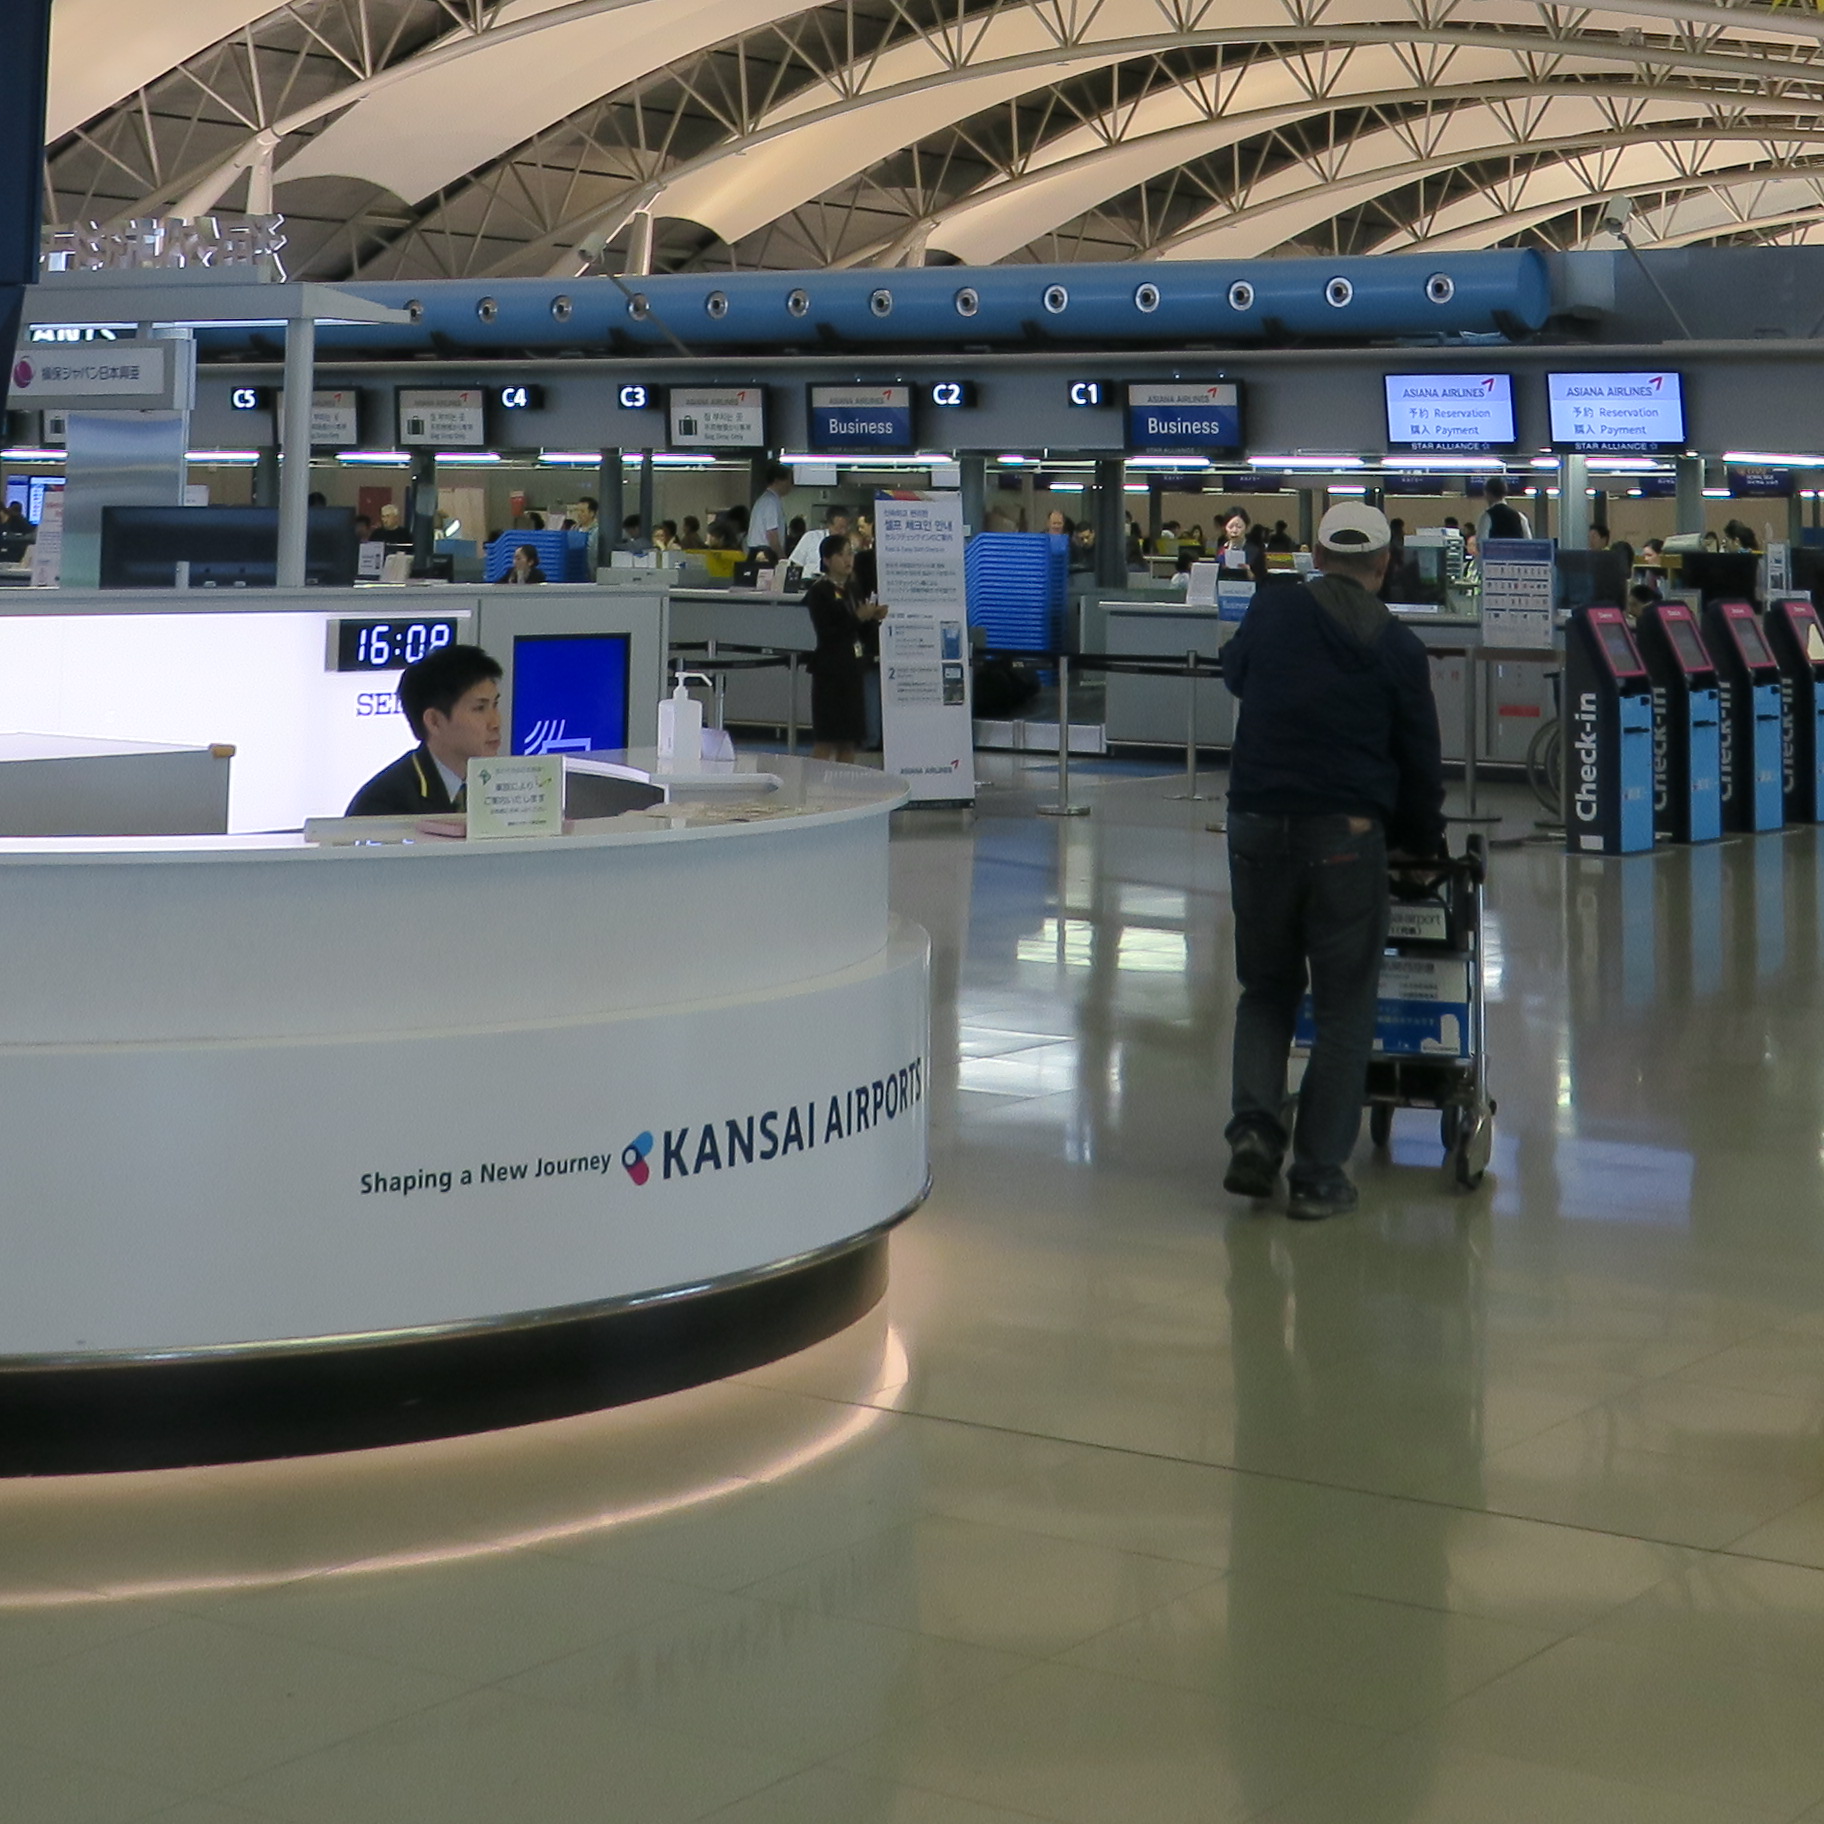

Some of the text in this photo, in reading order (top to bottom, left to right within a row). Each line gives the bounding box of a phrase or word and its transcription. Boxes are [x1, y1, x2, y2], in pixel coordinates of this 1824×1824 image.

[232, 388, 256, 409] C5
[501, 387, 527, 408] C4
[619, 386, 646, 407] C3
[932, 382, 962, 406] C2
[1070, 381, 1099, 405] C1
[1403, 387, 1485, 398] ASIANA AIRLINES
[1566, 386, 1653, 397] ASIANA AIRLINES
[1434, 408, 1491, 419] Reservation
[1599, 406, 1659, 417] Reservation
[828, 417, 894, 435] Business
[1147, 416, 1220, 435] Business
[1436, 425, 1479, 438] Payment
[1600, 424, 1647, 437] Payment
[1574, 692, 1597, 822] Check-in
[663, 1056, 921, 1180] KANSAI AIRPORTS
[360, 1153, 612, 1196] Shaping a New Journey
